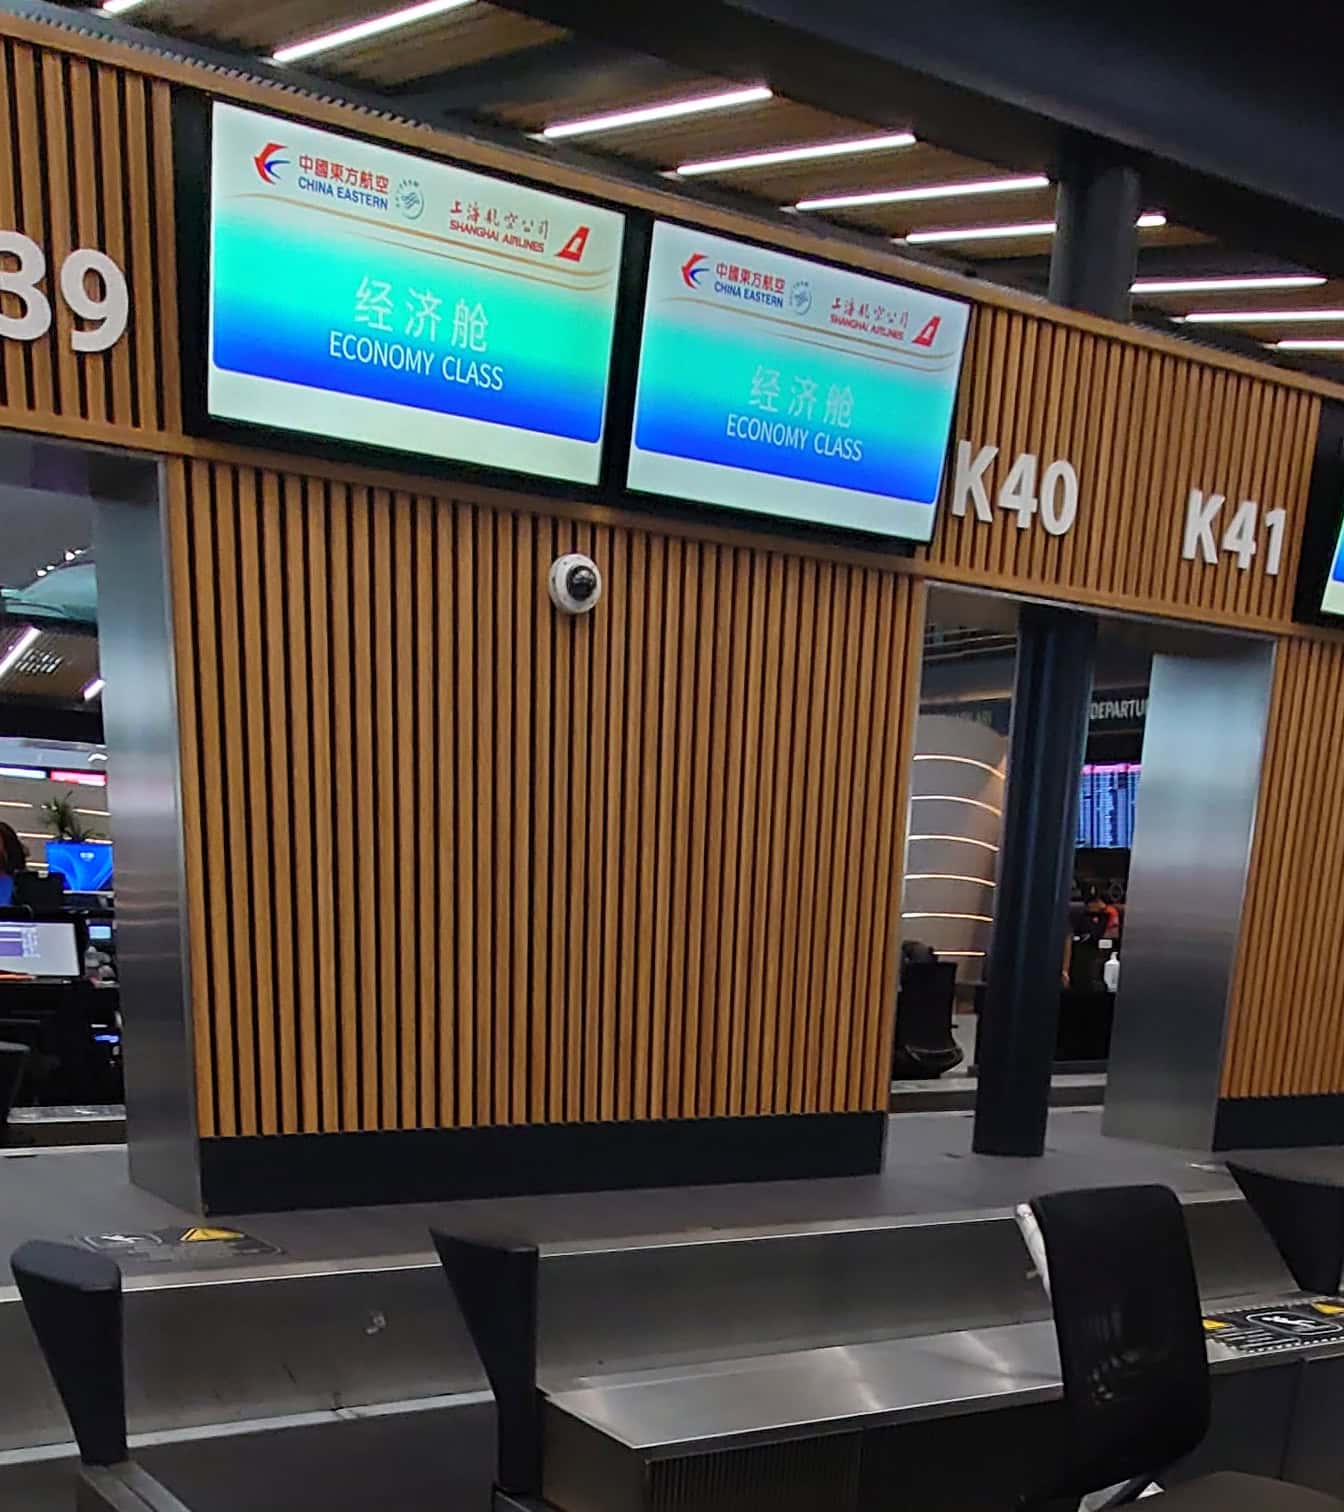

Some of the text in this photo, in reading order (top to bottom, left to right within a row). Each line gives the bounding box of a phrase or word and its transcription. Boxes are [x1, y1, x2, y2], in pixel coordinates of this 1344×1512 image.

[297, 176, 334, 198] CHINA
[337, 186, 389, 211] EASTERN
[298, 154, 390, 195] 中國東方航空
[448, 218, 545, 253] SHANGHAI AIRLINES
[713, 280, 784, 309] CHINA EASTERN
[715, 262, 786, 295] 中國東方航空
[353, 274, 489, 353] 经济舱
[329, 330, 504, 391] ECONOMY CLASS
[748, 363, 854, 429] 经济舱
[726, 412, 864, 462] ECONOMY CLASS
[951, 439, 1079, 537] K40
[1182, 488, 1286, 575] K41
[1089, 699, 1146, 719] DEPARTU
